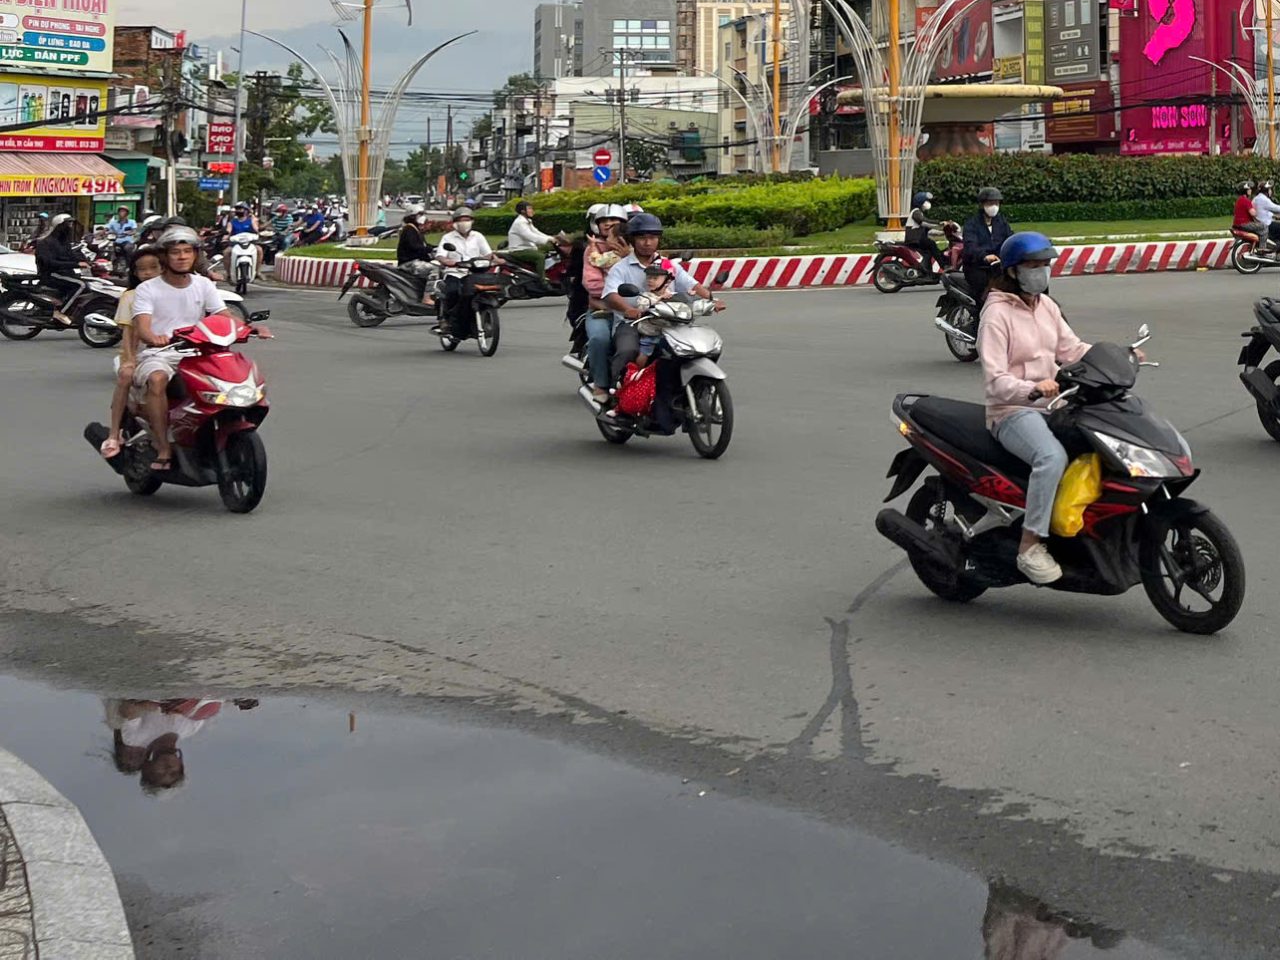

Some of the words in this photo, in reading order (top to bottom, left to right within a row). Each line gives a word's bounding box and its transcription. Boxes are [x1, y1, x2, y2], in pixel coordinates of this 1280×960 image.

[34, 50, 58, 61] DÁN
[60, 53, 81, 62] PPF
[33, 177, 79, 194] KINGKONG
